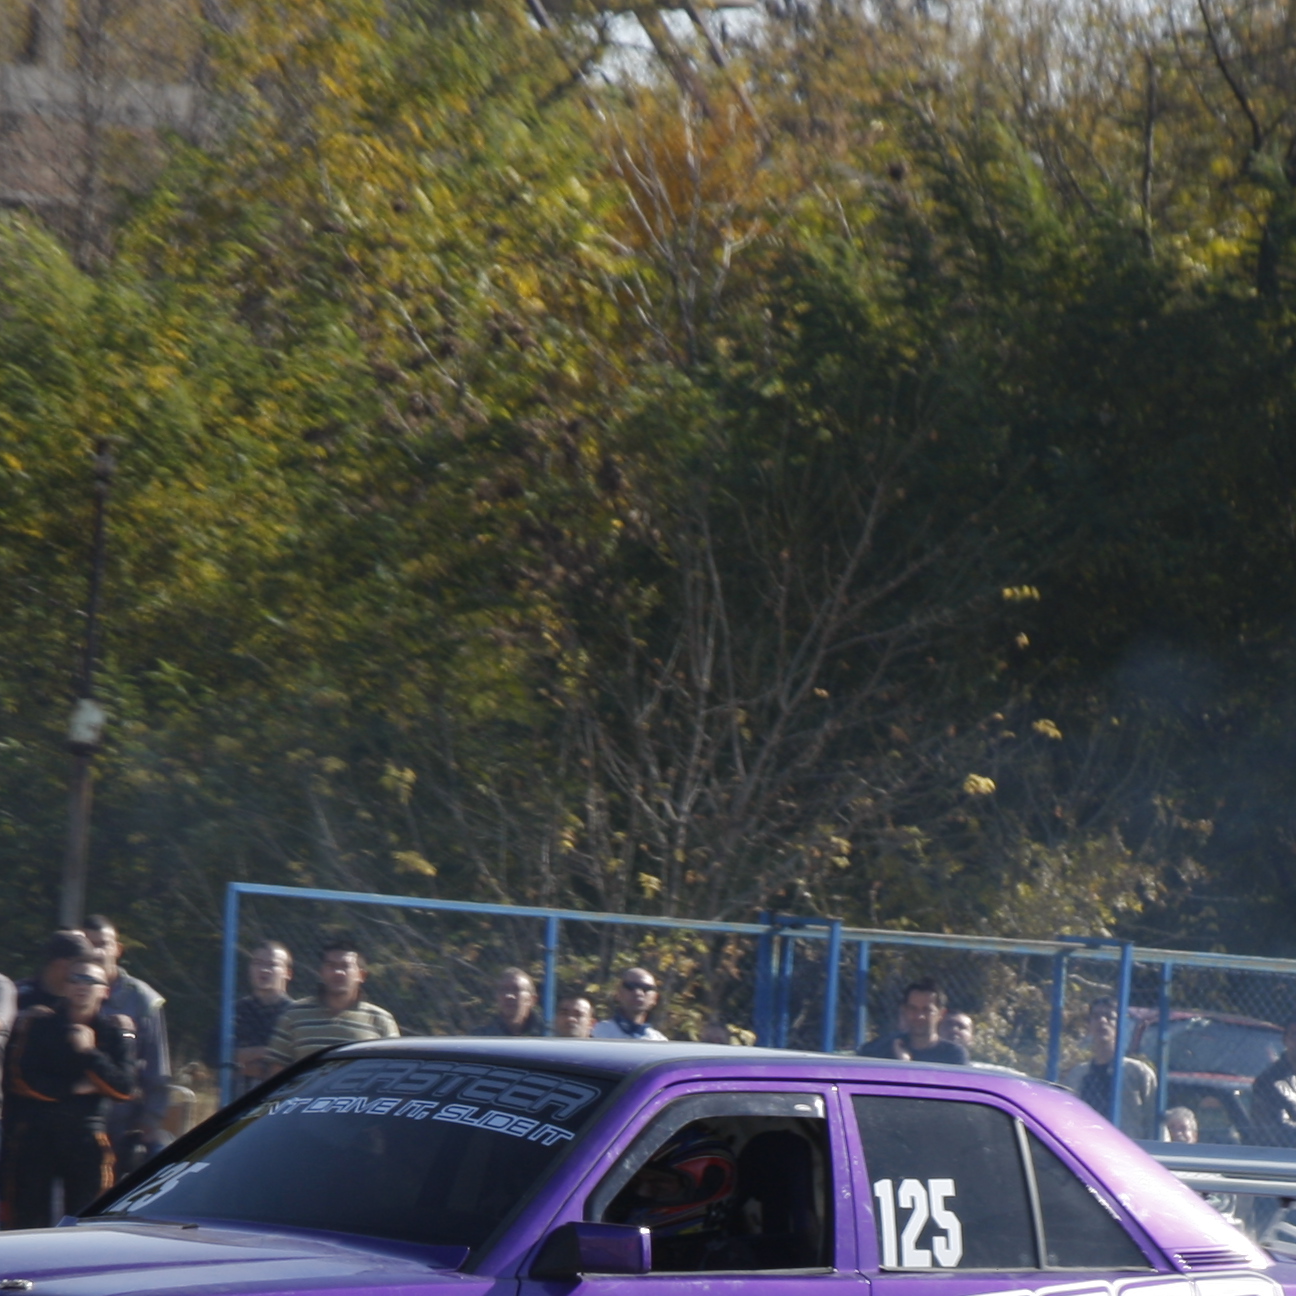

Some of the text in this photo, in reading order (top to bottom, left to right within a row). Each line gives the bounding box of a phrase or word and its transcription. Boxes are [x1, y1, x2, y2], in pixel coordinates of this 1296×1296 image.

[301, 1096, 403, 1116] DRIVE
[432, 1103, 538, 1139] SLIDE
[528, 1123, 575, 1146] IT
[873, 1178, 963, 1268] 125
